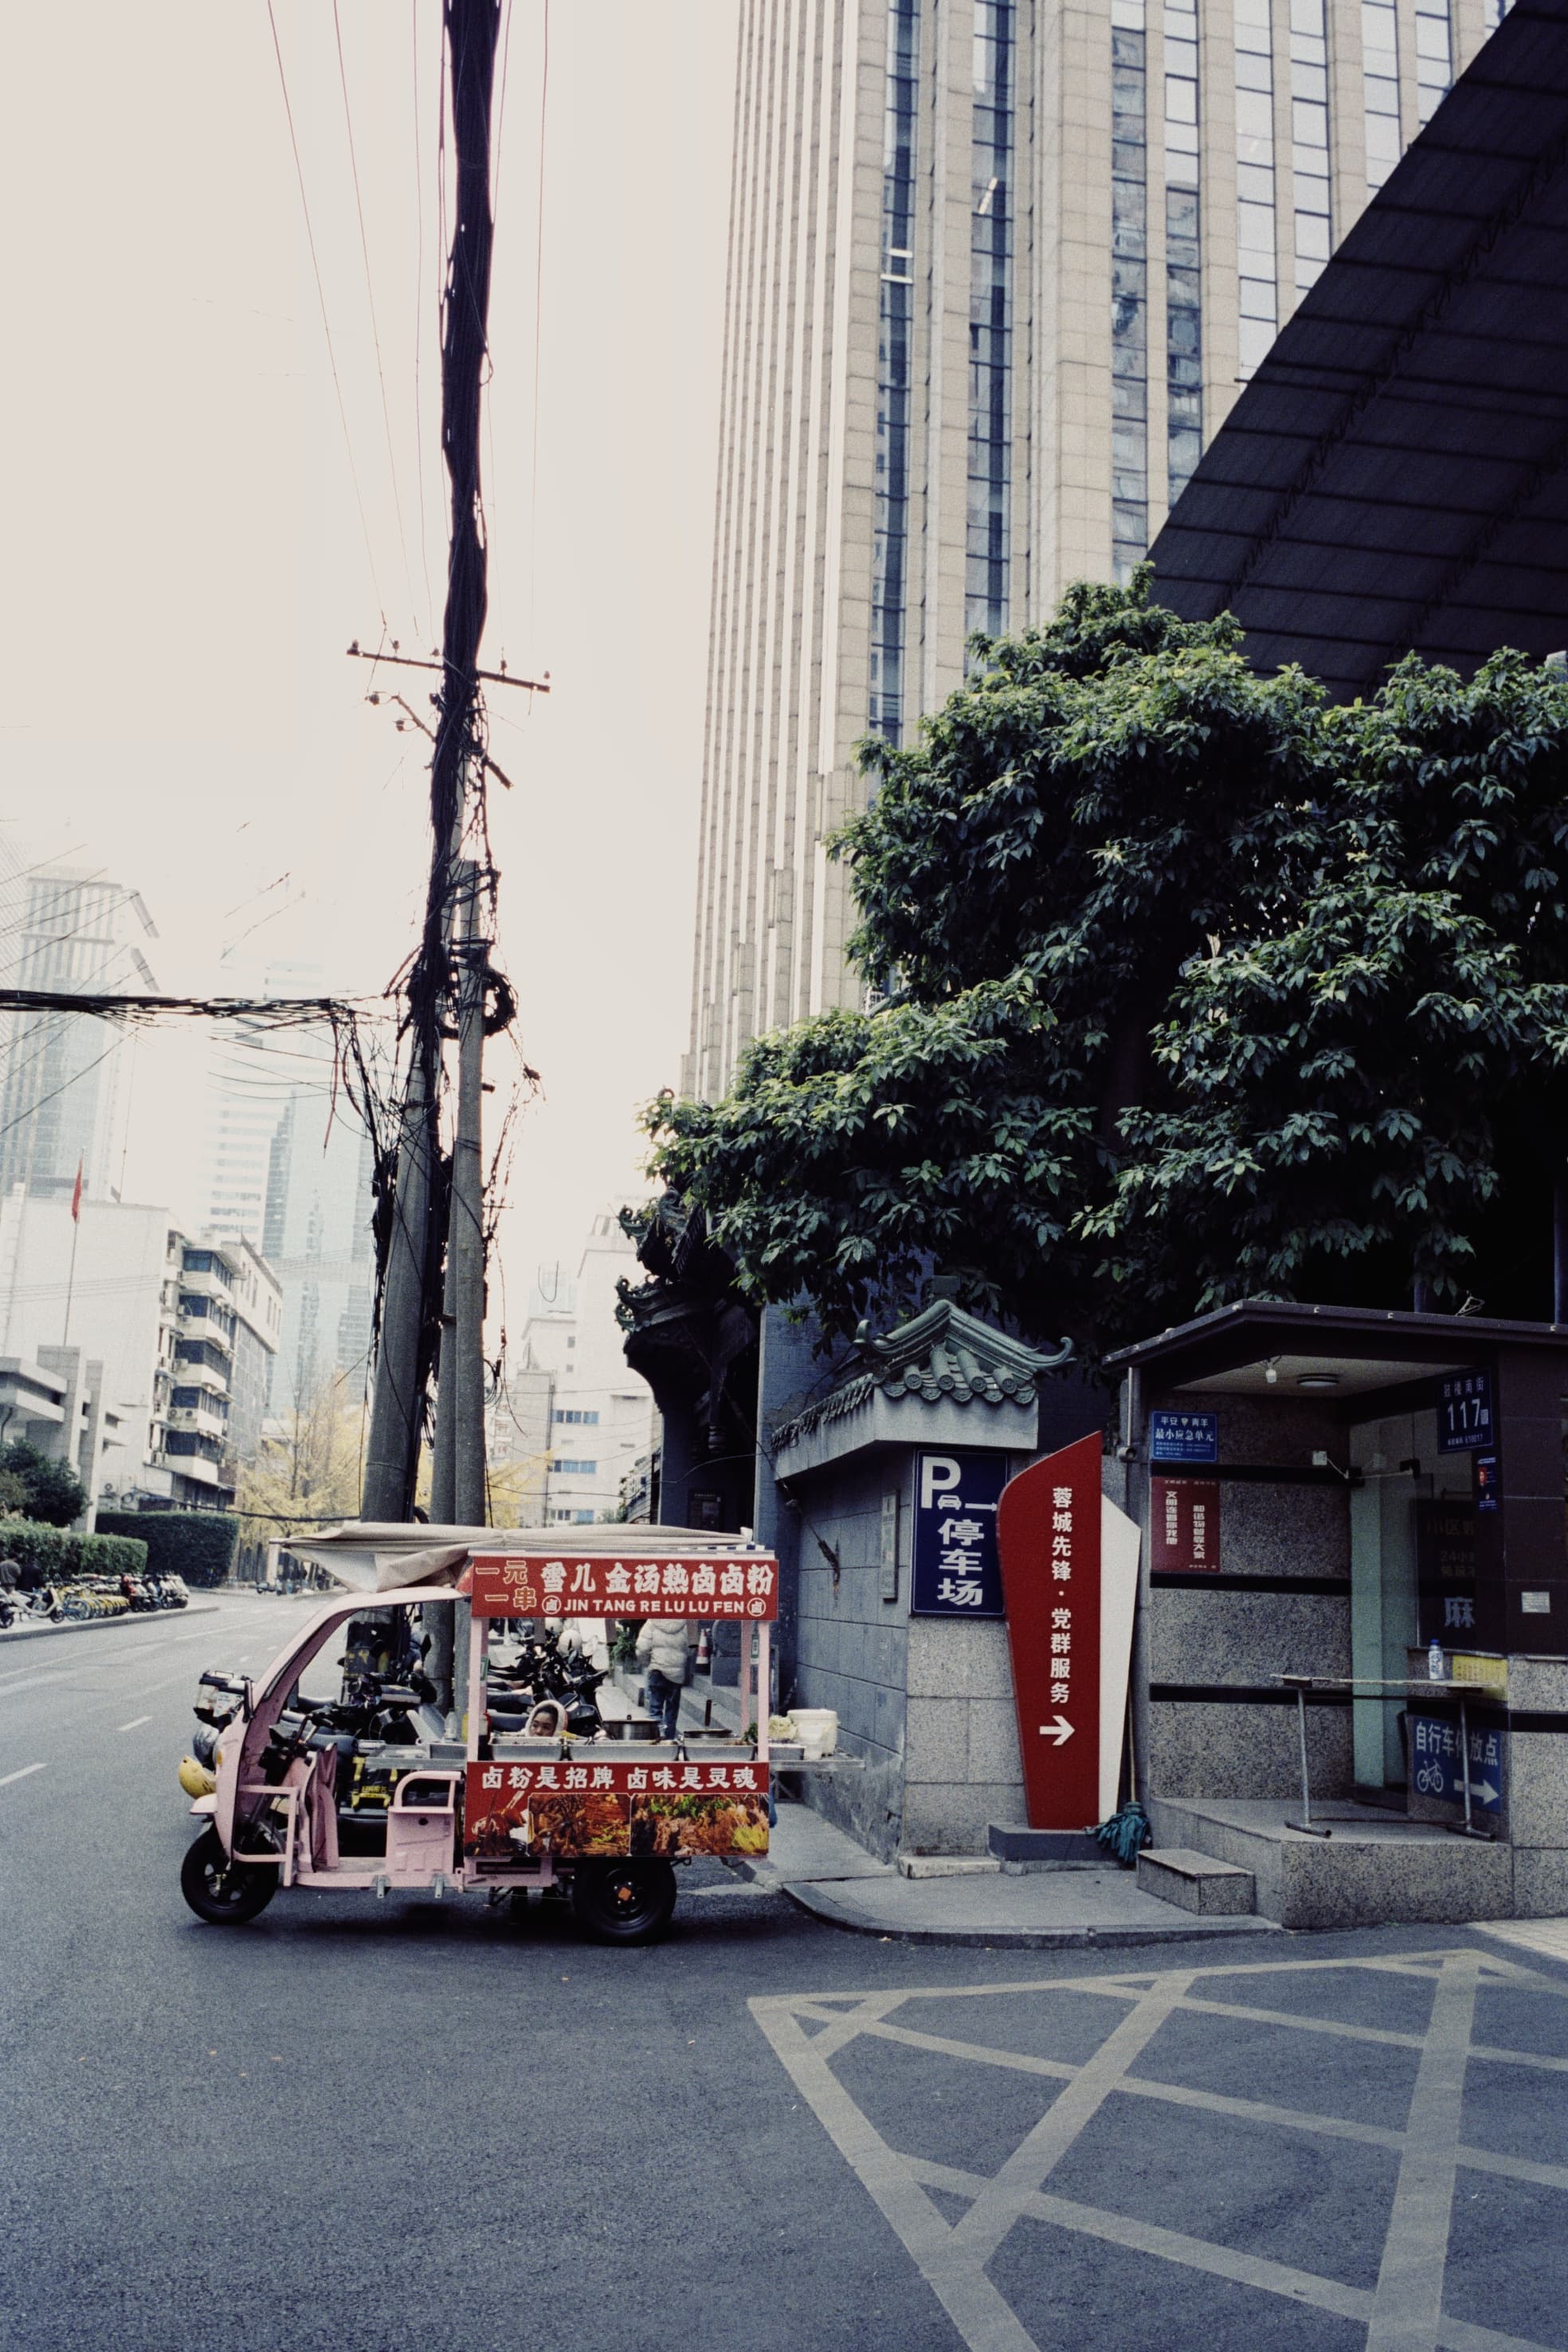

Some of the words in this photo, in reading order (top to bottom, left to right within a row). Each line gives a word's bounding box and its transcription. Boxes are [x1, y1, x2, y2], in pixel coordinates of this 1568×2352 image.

[1447, 1398, 1480, 1431] 117
[1155, 1428, 1214, 1441] 最小应急单元
[921, 1456, 962, 1509] P
[476, 1560, 528, 1585] 一元
[937, 1518, 985, 1607] 停车场
[540, 1562, 596, 1593] 雪儿
[606, 1562, 774, 1596] 金汤热卤卤粉
[485, 1586, 537, 1611] 一串
[564, 1599, 589, 1613] JIN
[593, 1599, 636, 1613] TANG
[640, 1600, 661, 1613] RE
[664, 1600, 685, 1613] LU
[689, 1601, 709, 1613] LU
[713, 1601, 745, 1613] FEN
[1444, 1596, 1476, 1629] 麻
[482, 1766, 615, 1789] 卤粉是招牌
[627, 1766, 759, 1790] 卤味是灵魂
